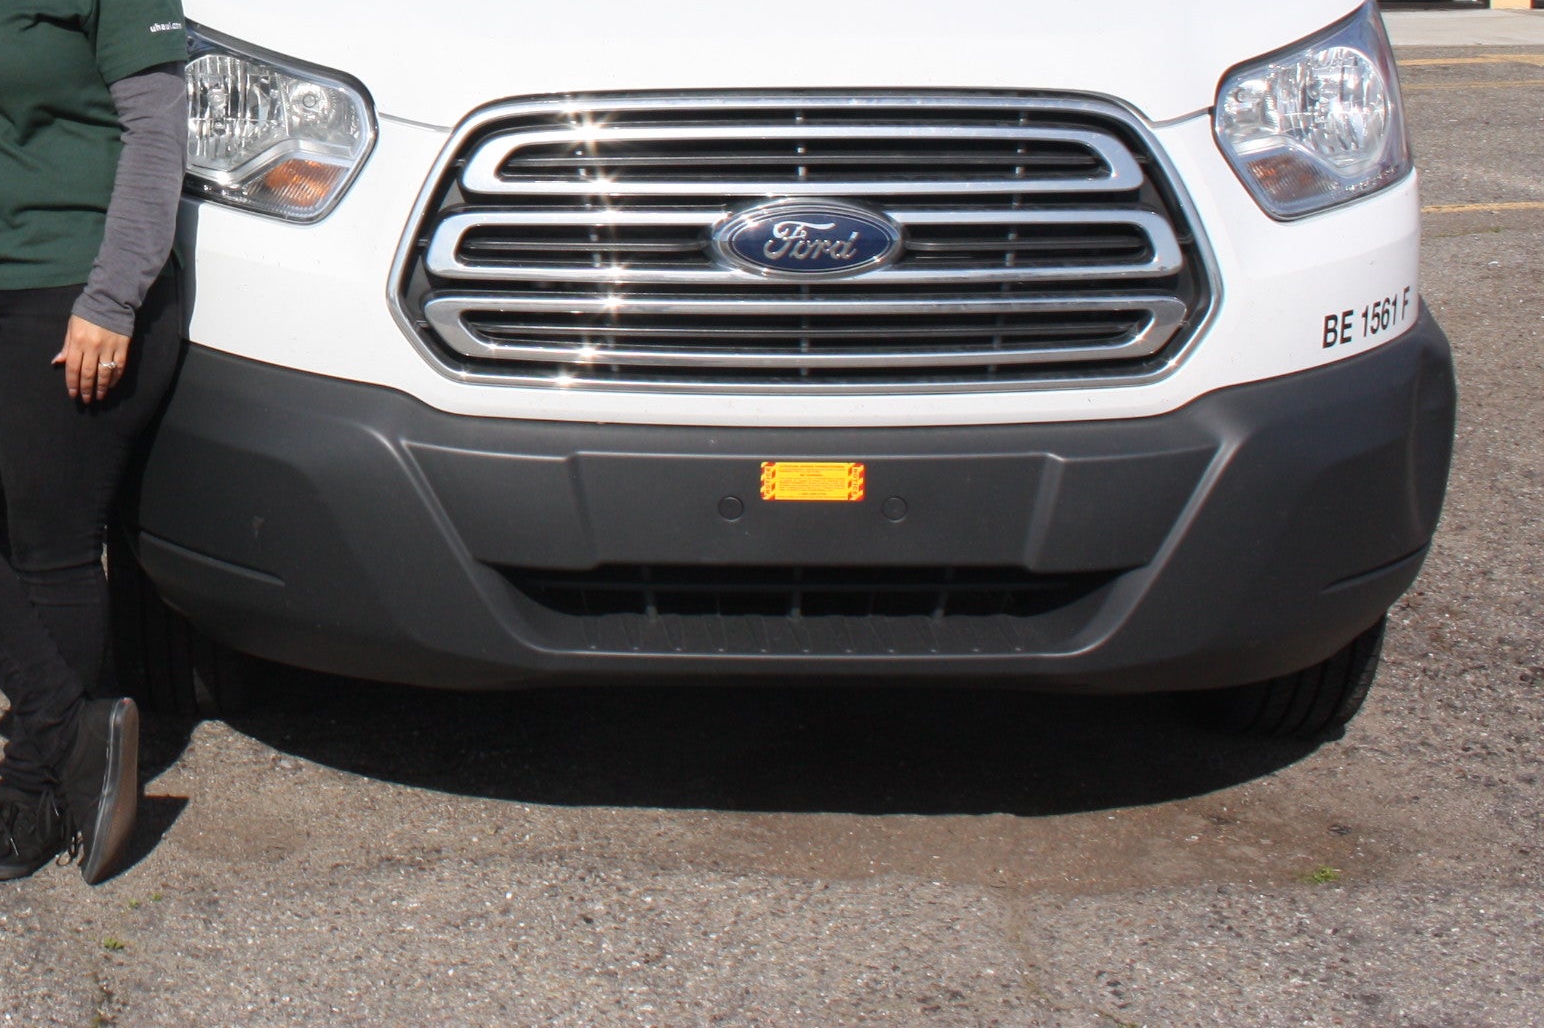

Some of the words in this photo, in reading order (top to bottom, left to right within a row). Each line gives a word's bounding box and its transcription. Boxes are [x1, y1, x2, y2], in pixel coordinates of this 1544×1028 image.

[762, 220, 860, 261] Ford
[1321, 308, 1354, 348] BE
[1360, 292, 1398, 338] 1561
[1400, 285, 1411, 321] F
